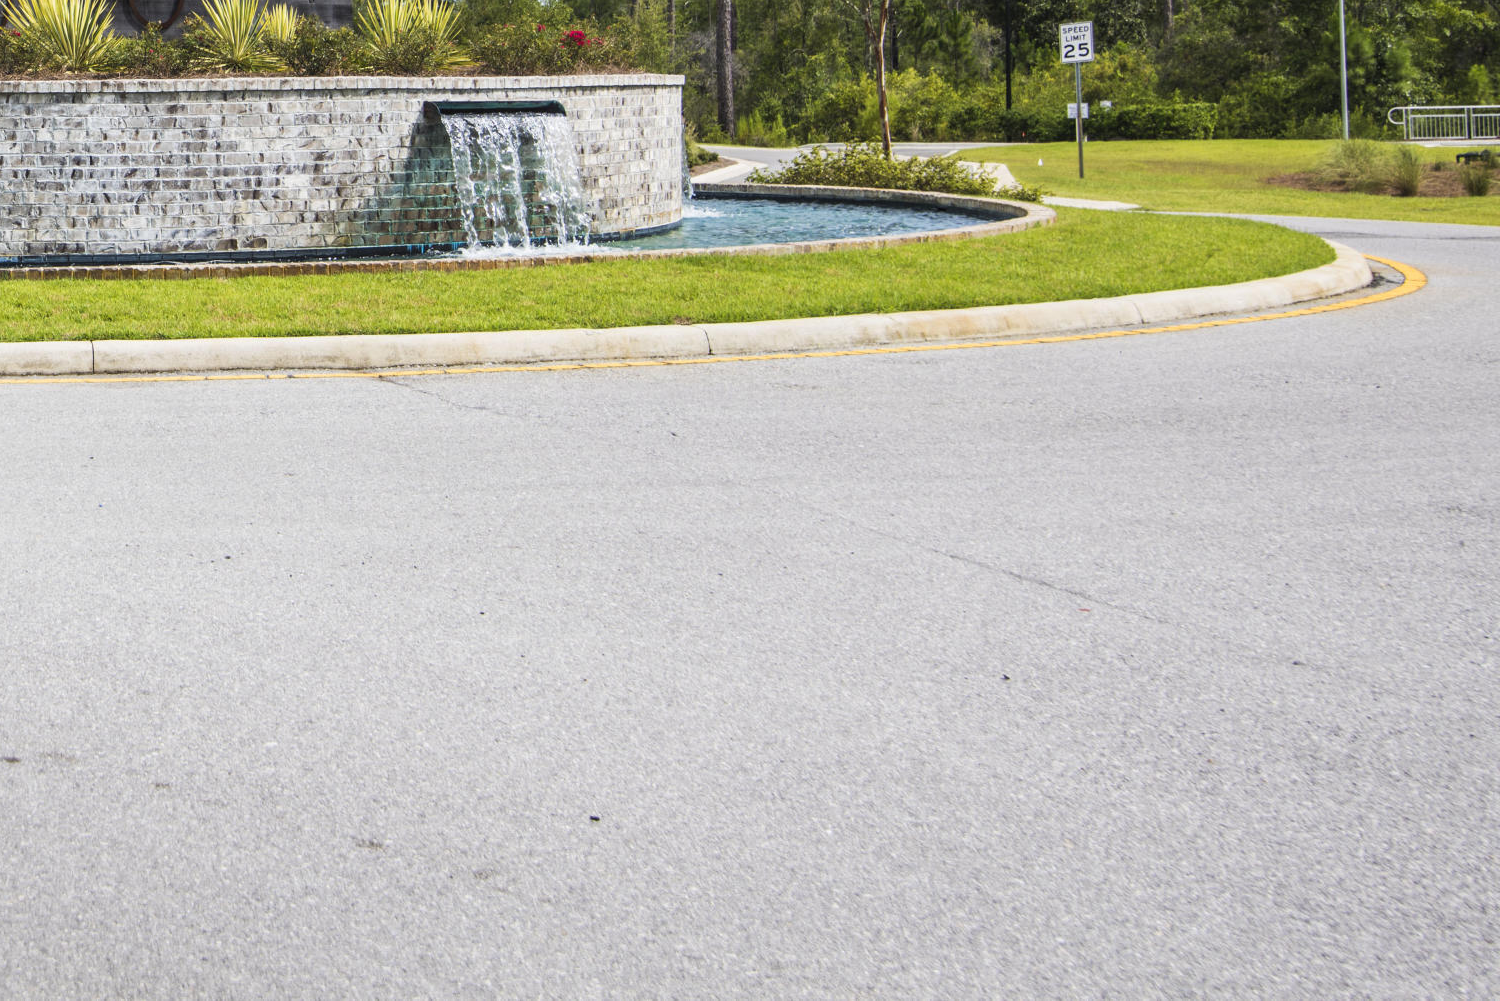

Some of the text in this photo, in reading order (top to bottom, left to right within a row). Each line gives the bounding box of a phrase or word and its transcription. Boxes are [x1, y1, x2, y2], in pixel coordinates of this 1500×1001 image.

[1062, 25, 1089, 34] SPEED
[1065, 33, 1086, 42] LIMIT
[1064, 42, 1090, 58] 25
